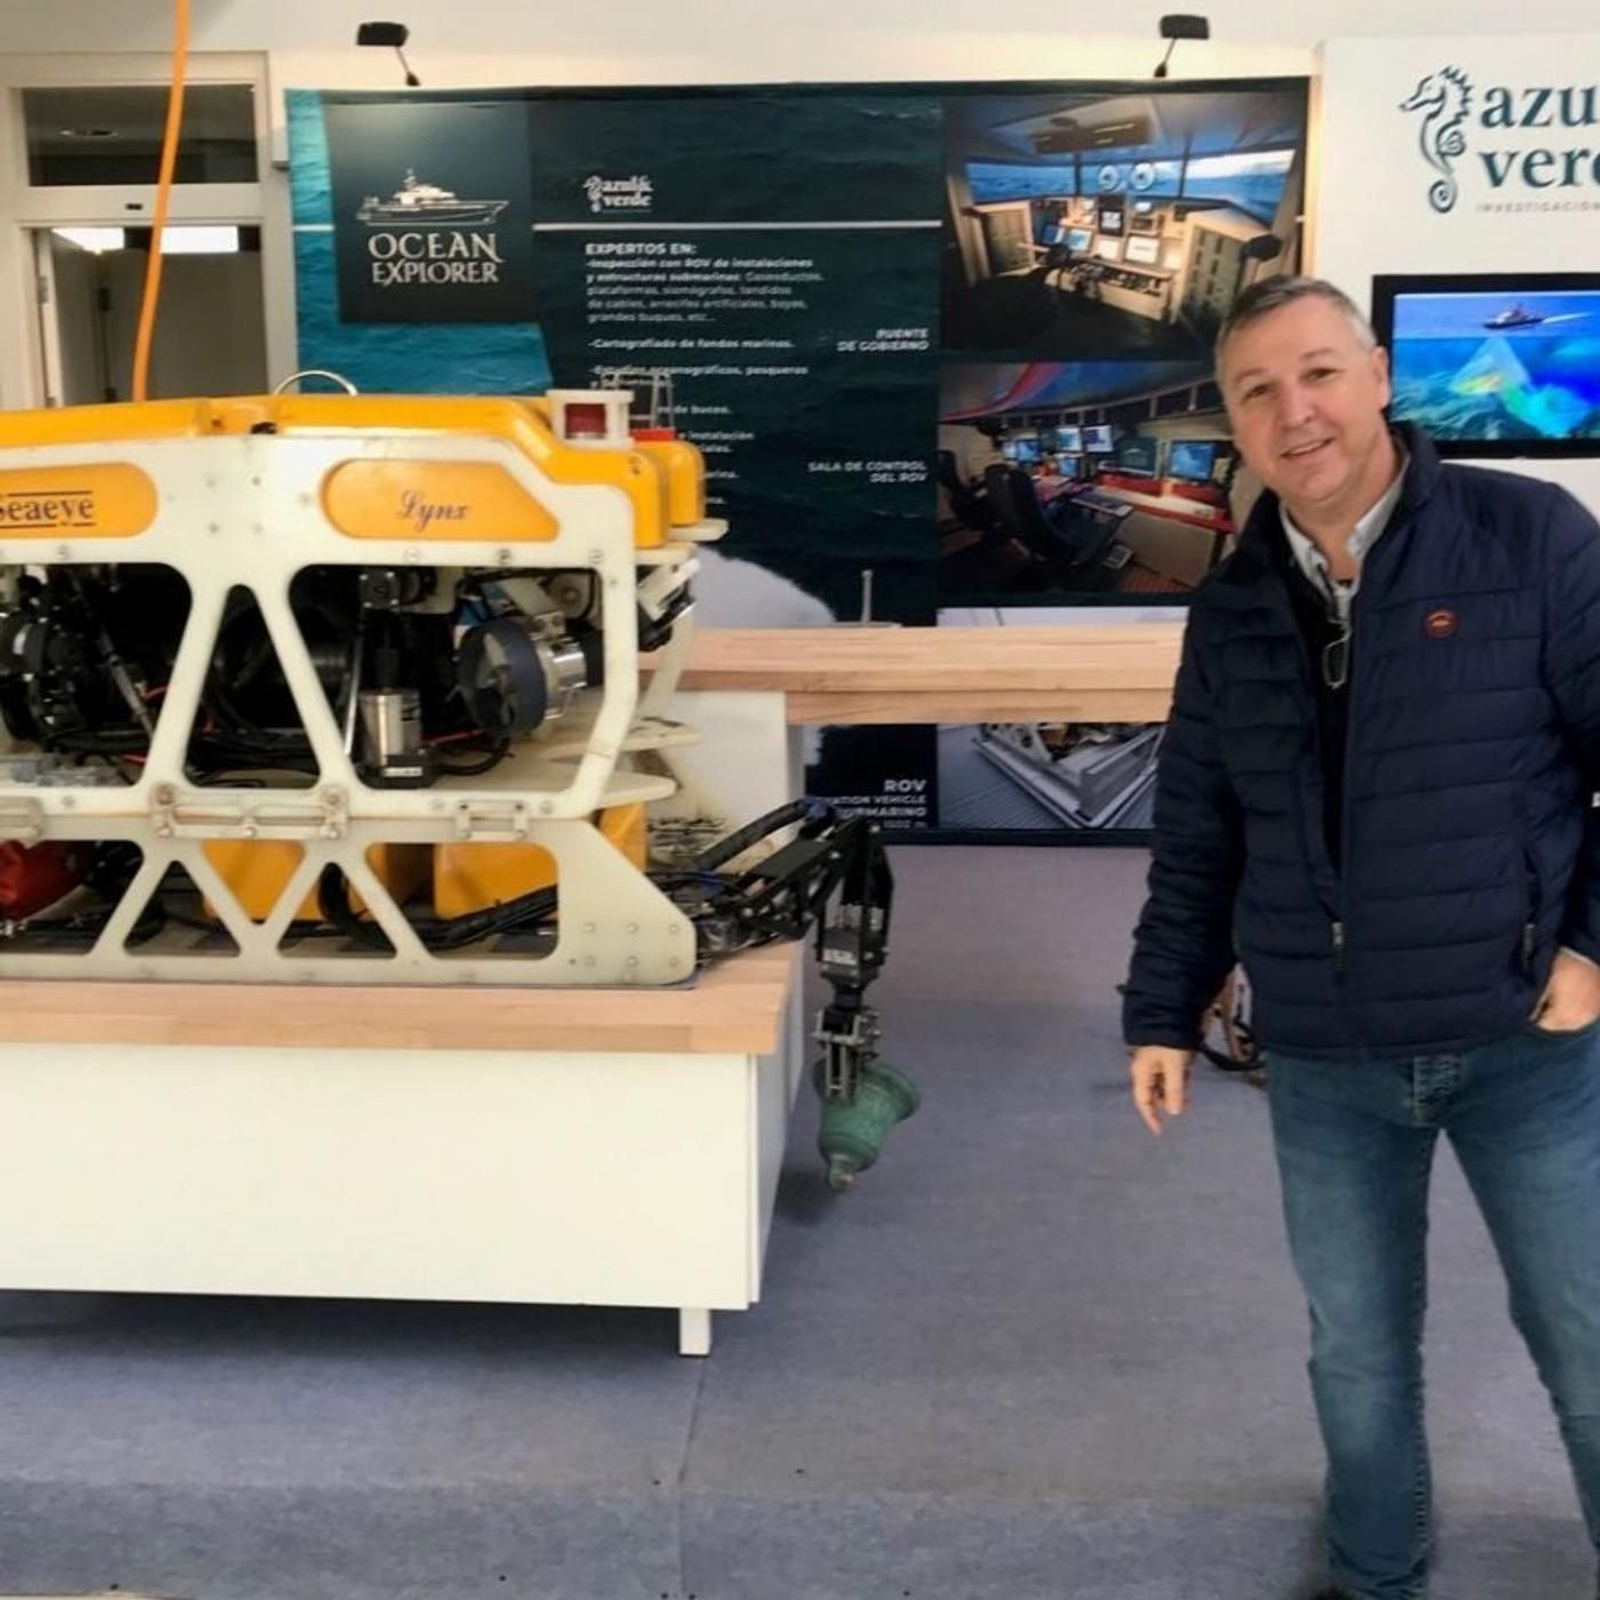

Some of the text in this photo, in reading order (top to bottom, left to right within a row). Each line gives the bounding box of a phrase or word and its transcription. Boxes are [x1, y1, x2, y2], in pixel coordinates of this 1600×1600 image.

[602, 191, 652, 207] verde
[368, 231, 506, 264] OCEAN
[585, 243, 698, 255] EXPERTOS EN:
[660, 259, 681, 268] con
[685, 258, 711, 268] ROV
[713, 258, 729, 268] de
[732, 257, 813, 268] instalaciones
[371, 259, 499, 287] EXPLORER
[597, 272, 666, 282] estructuras
[587, 299, 602, 309] de
[876, 328, 929, 339] PUENTE
[679, 339, 695, 348] de
[698, 338, 739, 348] fondos
[837, 340, 930, 352] DE GOBIERNO
[808, 460, 927, 472] SALA DE CONTROL
[870, 472, 928, 483] DEL ROV
[395, 489, 473, 533] Lynx
[883, 779, 927, 793] ROV
